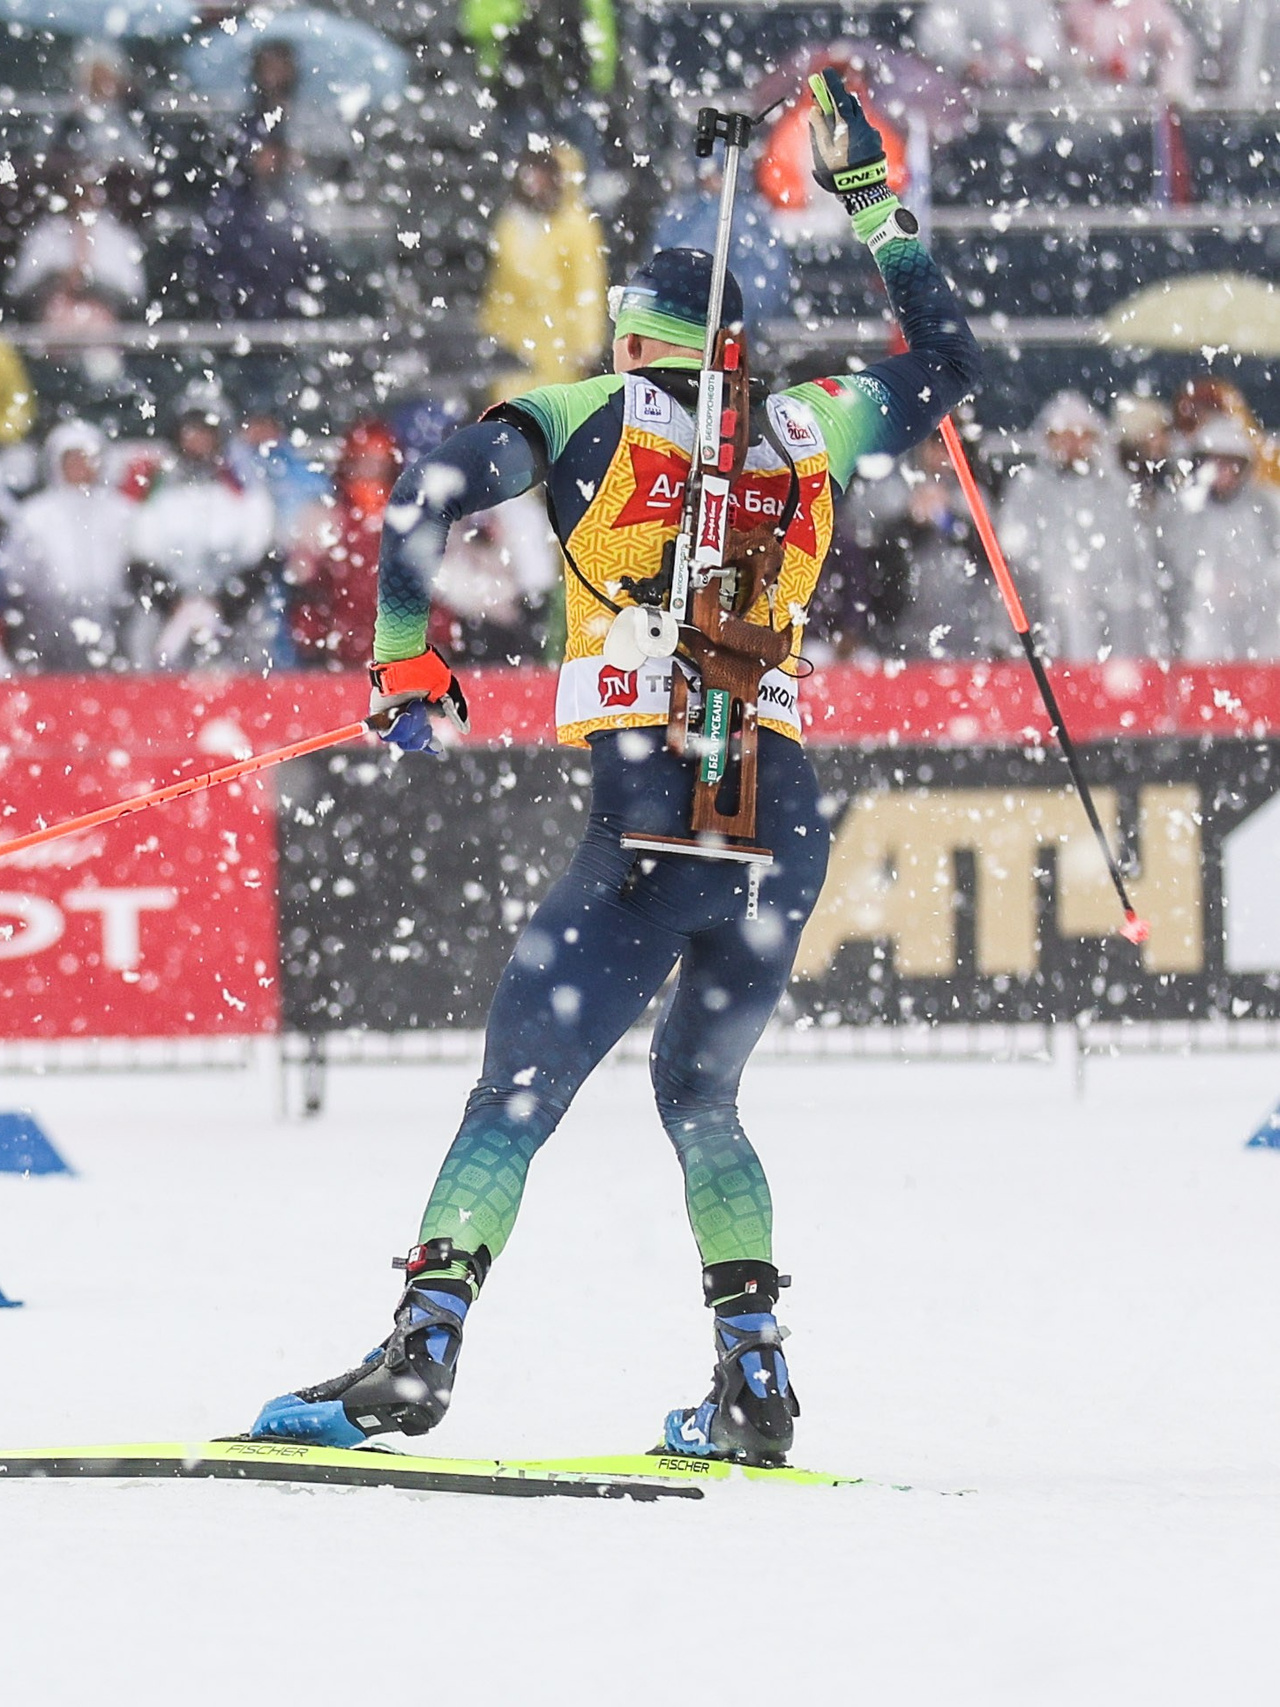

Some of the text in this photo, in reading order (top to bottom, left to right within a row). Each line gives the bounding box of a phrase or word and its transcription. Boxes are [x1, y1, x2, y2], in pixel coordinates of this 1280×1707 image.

[709, 692, 723, 769] БЕЛРУСБАНК
[790, 782, 1202, 976] АТЧ
[225, 1445, 309, 1458] FISCHER
[659, 1459, 709, 1474] FISCHER
